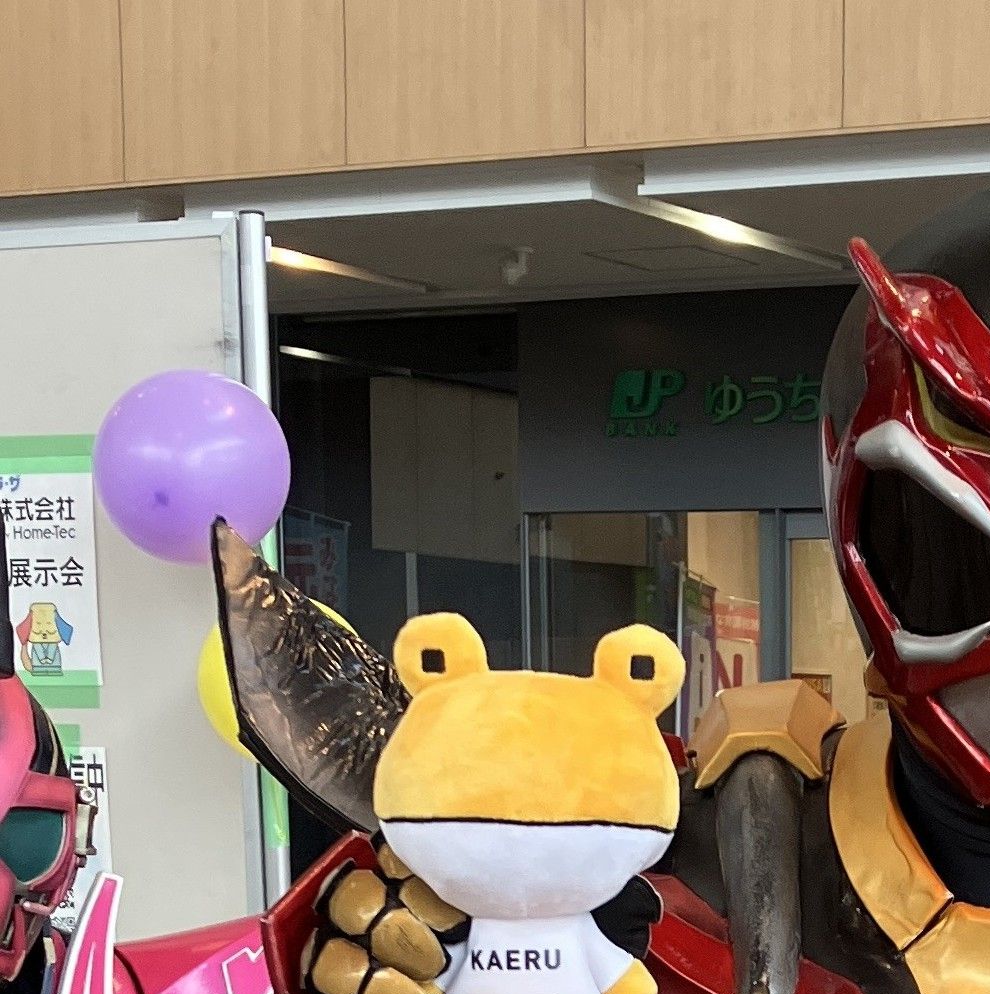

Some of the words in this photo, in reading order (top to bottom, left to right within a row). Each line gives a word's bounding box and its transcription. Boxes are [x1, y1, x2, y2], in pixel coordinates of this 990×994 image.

[609, 369, 685, 418] JP
[9, 556, 84, 588] 展示会
[470, 948, 562, 971] KAERU
